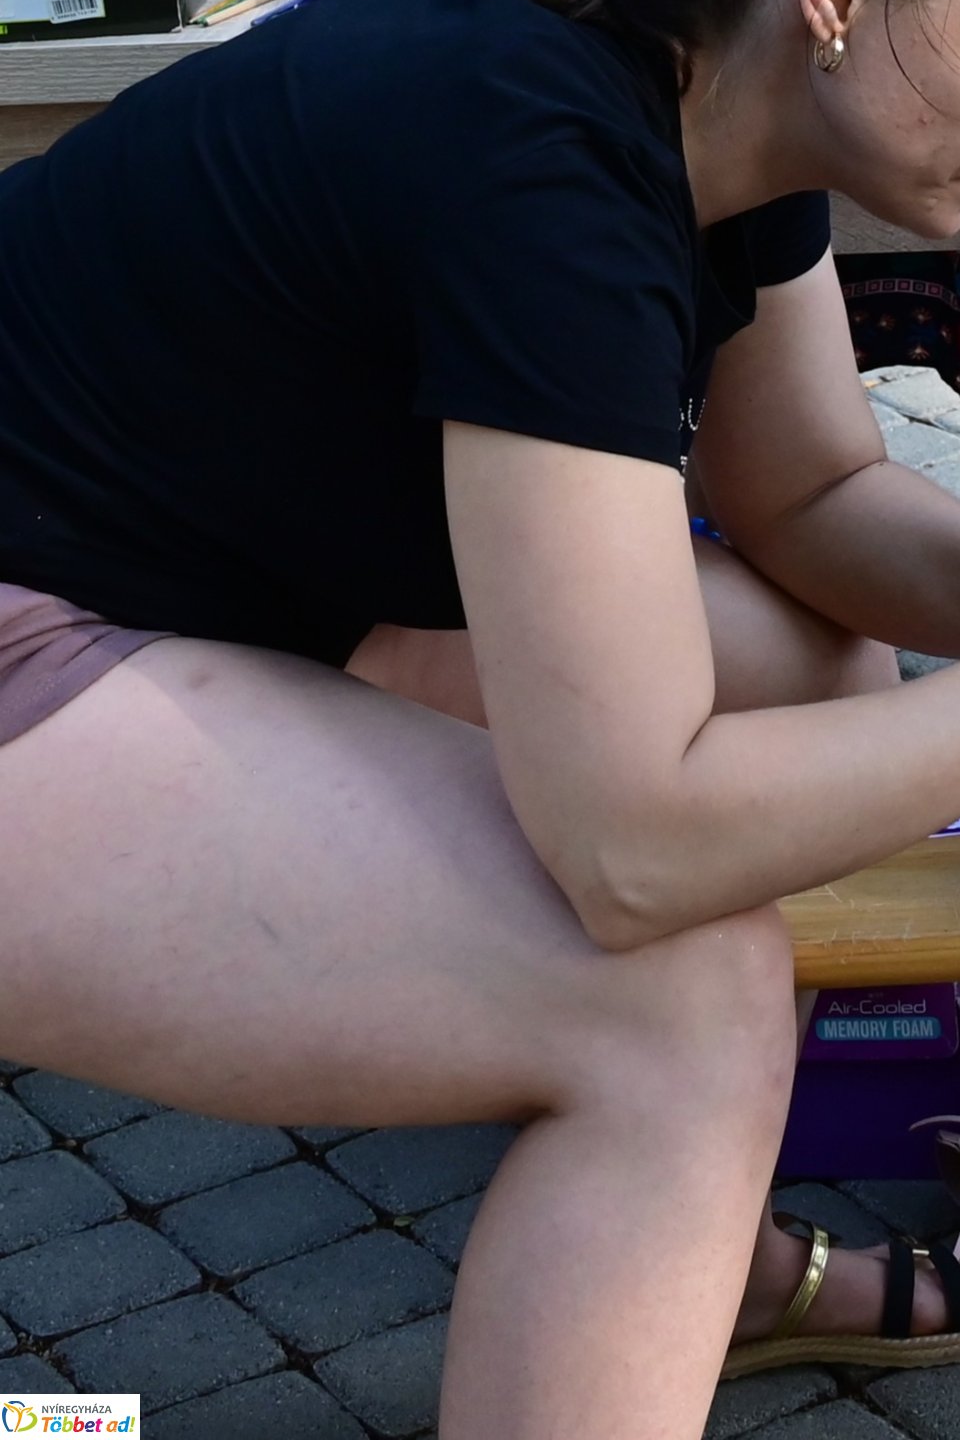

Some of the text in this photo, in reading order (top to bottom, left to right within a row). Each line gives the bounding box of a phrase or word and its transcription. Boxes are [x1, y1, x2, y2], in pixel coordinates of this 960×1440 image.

[828, 1000, 927, 1015] Air-Cooled
[823, 1019, 934, 1038] MEMORY FOAM
